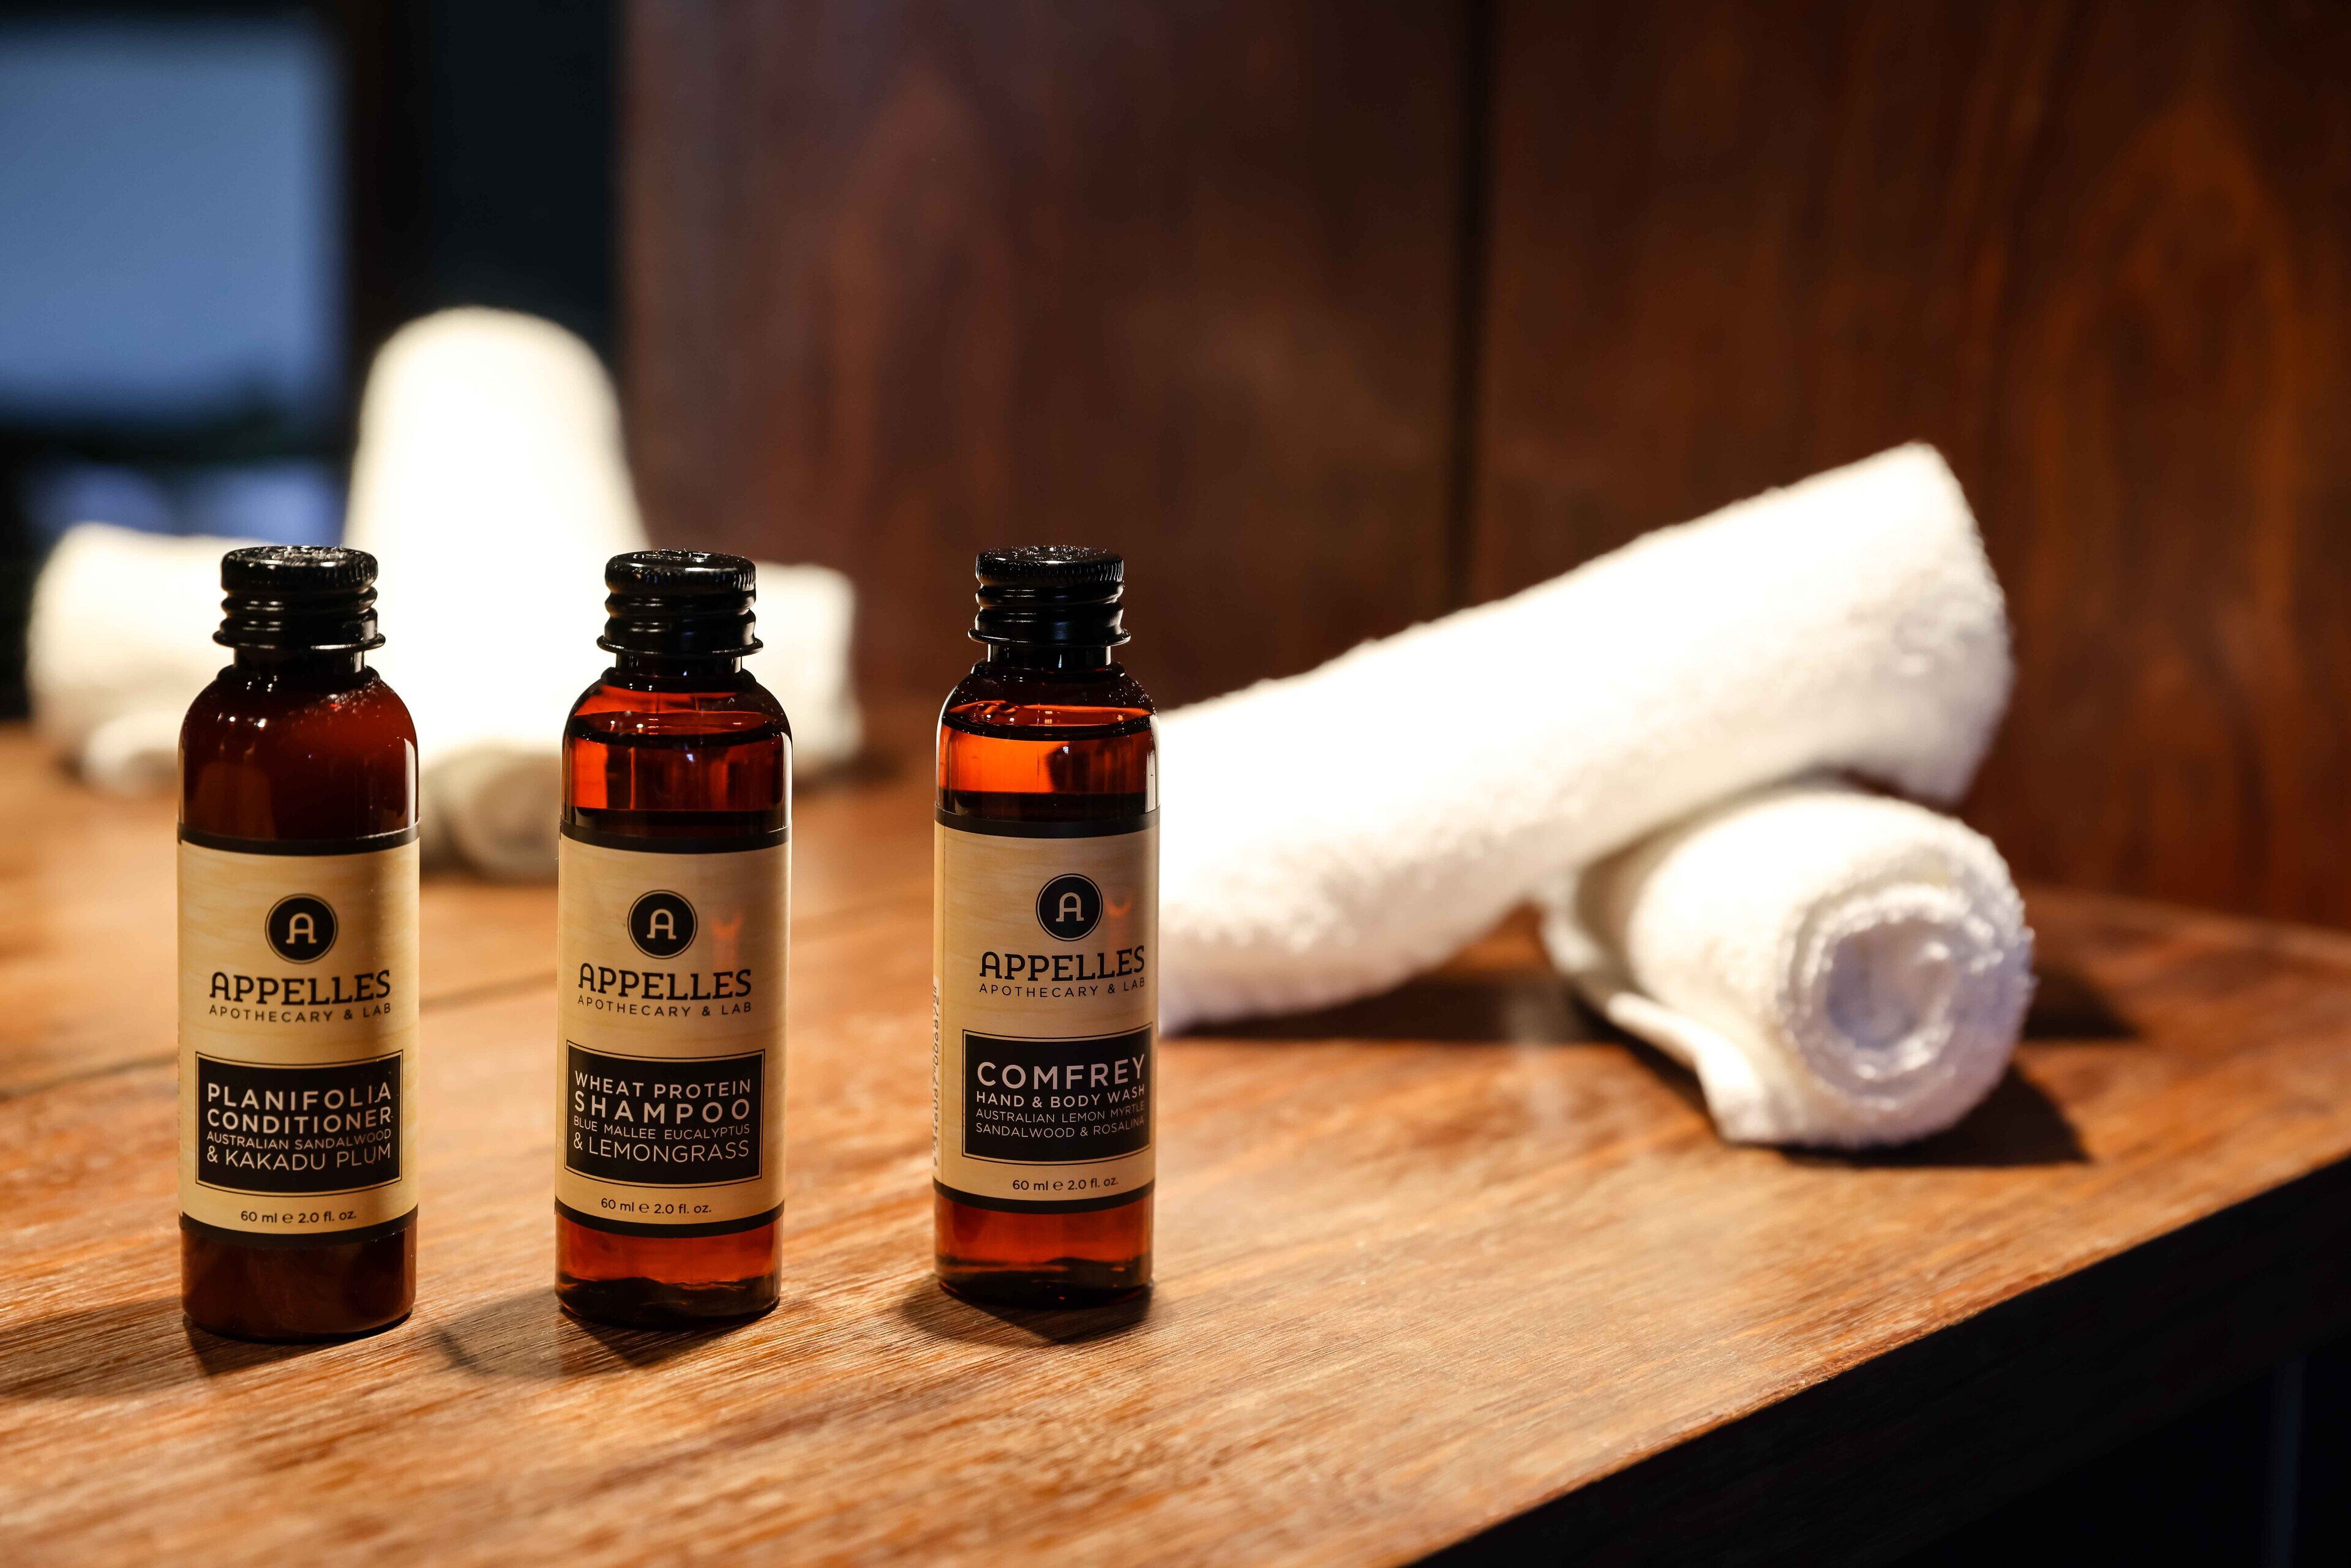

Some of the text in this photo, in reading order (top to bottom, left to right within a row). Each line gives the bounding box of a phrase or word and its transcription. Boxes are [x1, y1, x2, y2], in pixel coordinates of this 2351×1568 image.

[1056, 892, 1084, 922] A
[285, 912, 317, 944] A
[647, 909, 677, 940] A
[980, 945, 1145, 981] APPELLES
[209, 970, 391, 1005] APPELLES
[578, 962, 752, 1000] APPELLES
[980, 977, 1145, 997] APOTHECARY & LAB
[209, 1003, 391, 1022] APOTHECARY & LAB
[578, 995, 751, 1016] APOTHECARY & LAB
[576, 1070, 751, 1098] WHEAT PROTEIN
[977, 1054, 1145, 1090] COMFREY
[208, 1082, 391, 1111] PLANIFOLIA
[574, 1090, 749, 1124] SHAMPOO
[977, 1084, 1144, 1108] HAND & BODY WASH
[207, 1106, 391, 1134] CONDITIONER
[976, 1101, 1144, 1123] AUSTRALIAN LEMON MYRTLE
[207, 1129, 391, 1150] AUSTRALIAN SANDALWOOD
[574, 1116, 749, 1140] BLUE MALLEE EUCALYPTUS
[976, 1116, 1144, 1138] SANDALWOOD & ROSALINA
[207, 1142, 391, 1171] & KAKADU PLUM
[573, 1132, 749, 1163] & LEMONGRASS
[1013, 1180, 1029, 1190] 60
[1033, 1180, 1048, 1190] ml
[1068, 1179, 1086, 1190] 2.0
[1090, 1177, 1100, 1188] fl.
[1103, 1177, 1118, 1187] oz.
[241, 1211, 257, 1222] 60
[262, 1213, 277, 1223] ml
[299, 1212, 319, 1223] 2.0
[323, 1211, 334, 1222] fl.
[339, 1211, 356, 1220] oz.
[601, 1198, 616, 1209] 60
[620, 1201, 634, 1212] ml
[654, 1204, 673, 1214] 2.0
[678, 1204, 689, 1214] fl.
[694, 1204, 711, 1213] oz.
